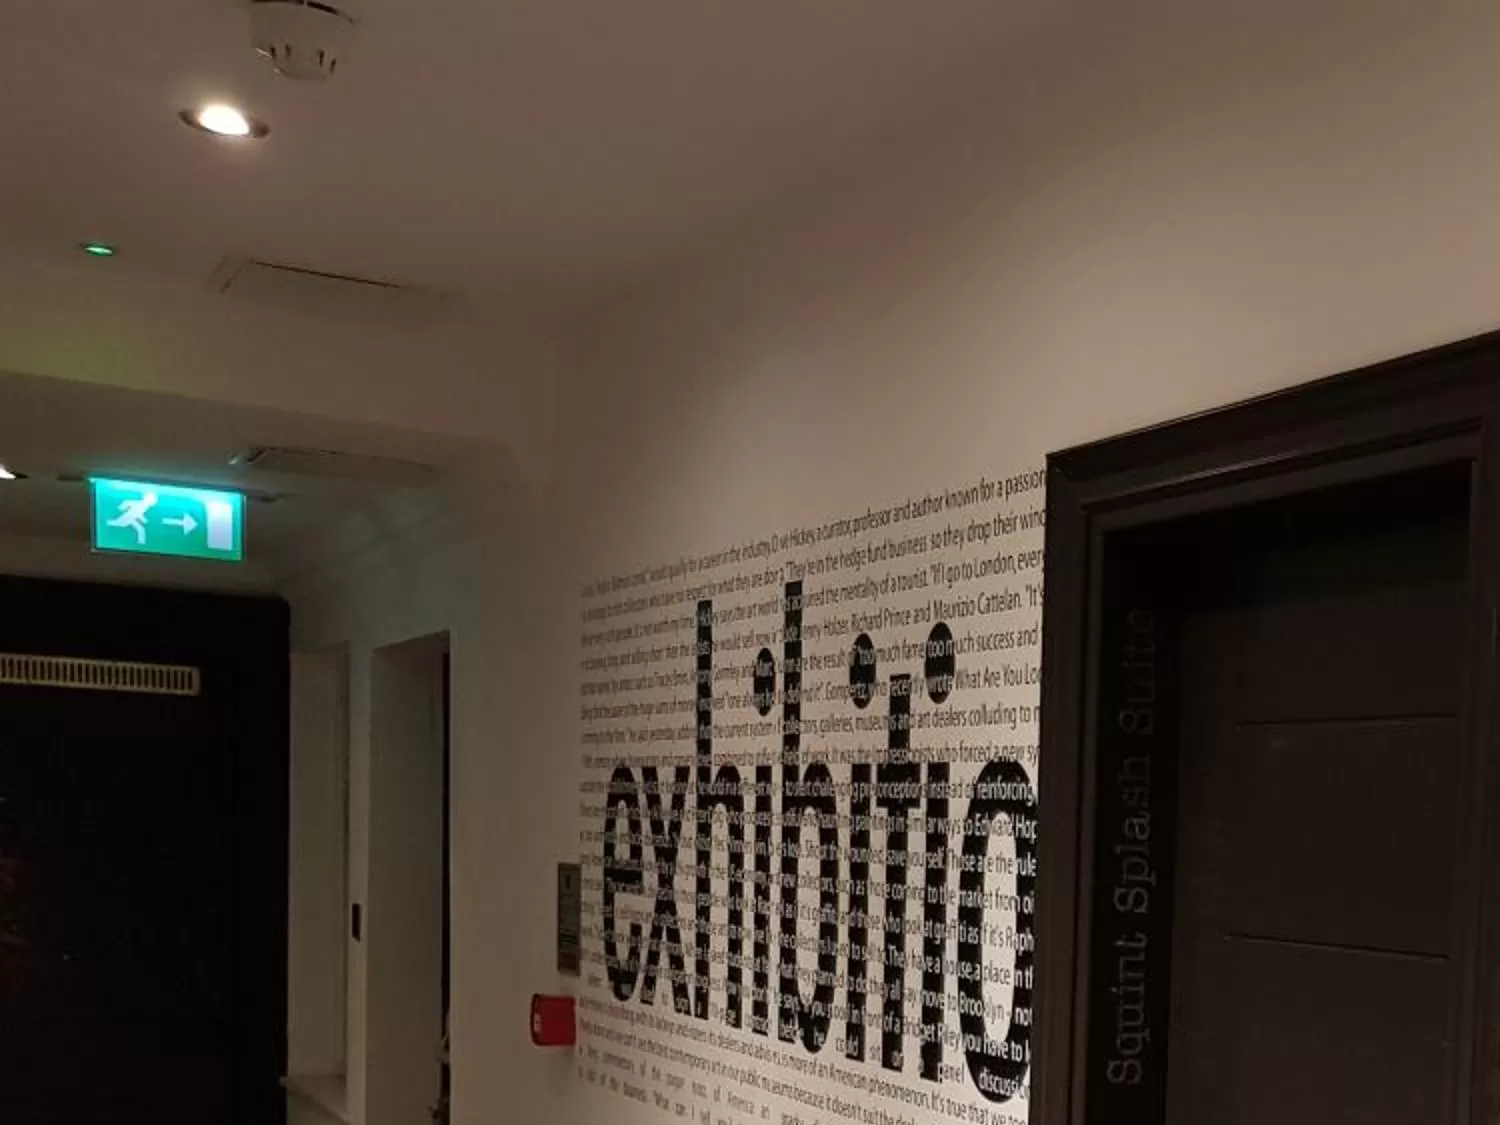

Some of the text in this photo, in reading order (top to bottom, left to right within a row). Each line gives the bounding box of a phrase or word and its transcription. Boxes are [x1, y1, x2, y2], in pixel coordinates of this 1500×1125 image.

[910, 492, 942, 519] author
[1005, 467, 1044, 503] passion
[967, 518, 990, 545] drop
[992, 510, 1017, 537] their
[946, 564, 959, 588] go
[961, 560, 972, 580] to
[913, 599, 929, 623] and
[928, 637, 944, 656] too
[976, 629, 1016, 651] success
[1017, 620, 1038, 646] and
[1004, 662, 1022, 685] You
[932, 699, 1032, 729] dealers colluding to
[1113, 751, 1156, 914] Splash
[1106, 933, 1151, 1085] Squint
[945, 1095, 965, 1119] true
[968, 1098, 988, 1125] that
